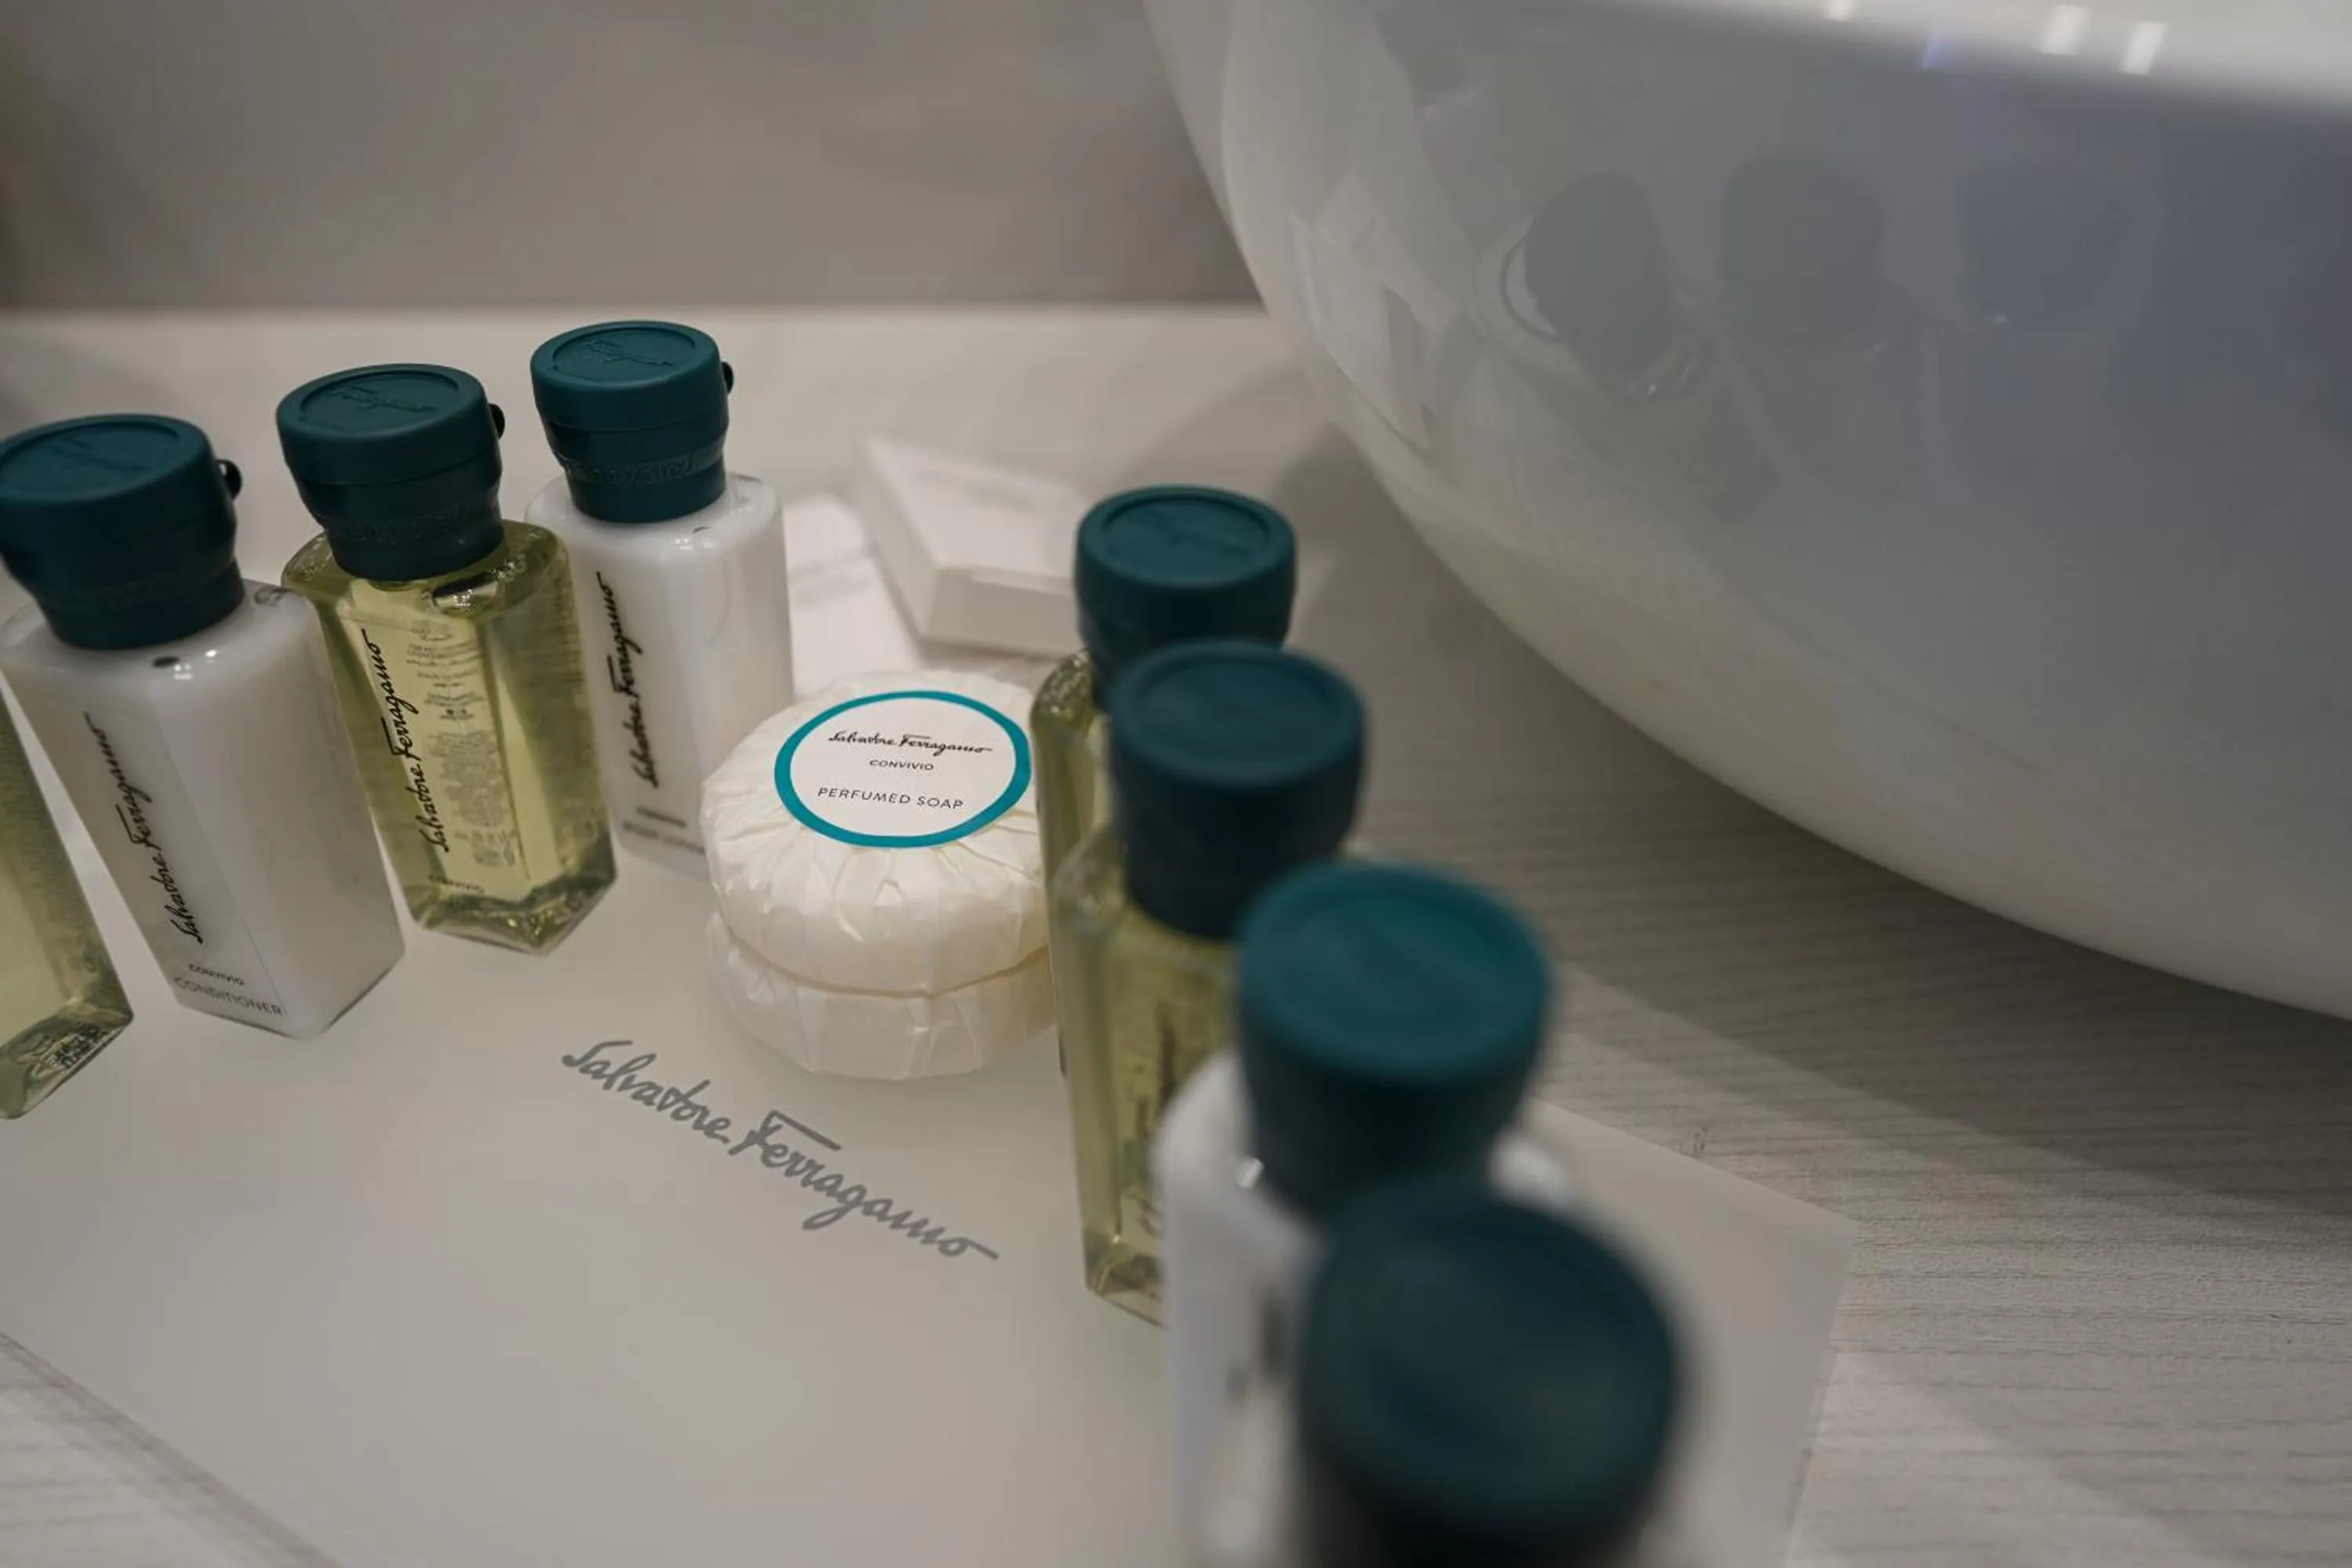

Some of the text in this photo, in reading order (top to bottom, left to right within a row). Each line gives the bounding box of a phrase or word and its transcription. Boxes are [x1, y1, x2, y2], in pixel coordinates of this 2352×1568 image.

[361, 627, 450, 854] Salvatore Ferragamo
[597, 571, 659, 789] Salvatore Ferragamo
[828, 730, 994, 757] Salvatore Ferragamo
[83, 711, 204, 946] Salvatore Ferragamo
[817, 787, 964, 811] PERFUMED SOAP
[869, 758, 935, 771] CONVIVIO
[173, 977, 285, 1017] CONDITIONER
[561, 1039, 1000, 1261] Salvatore Ferragamo
